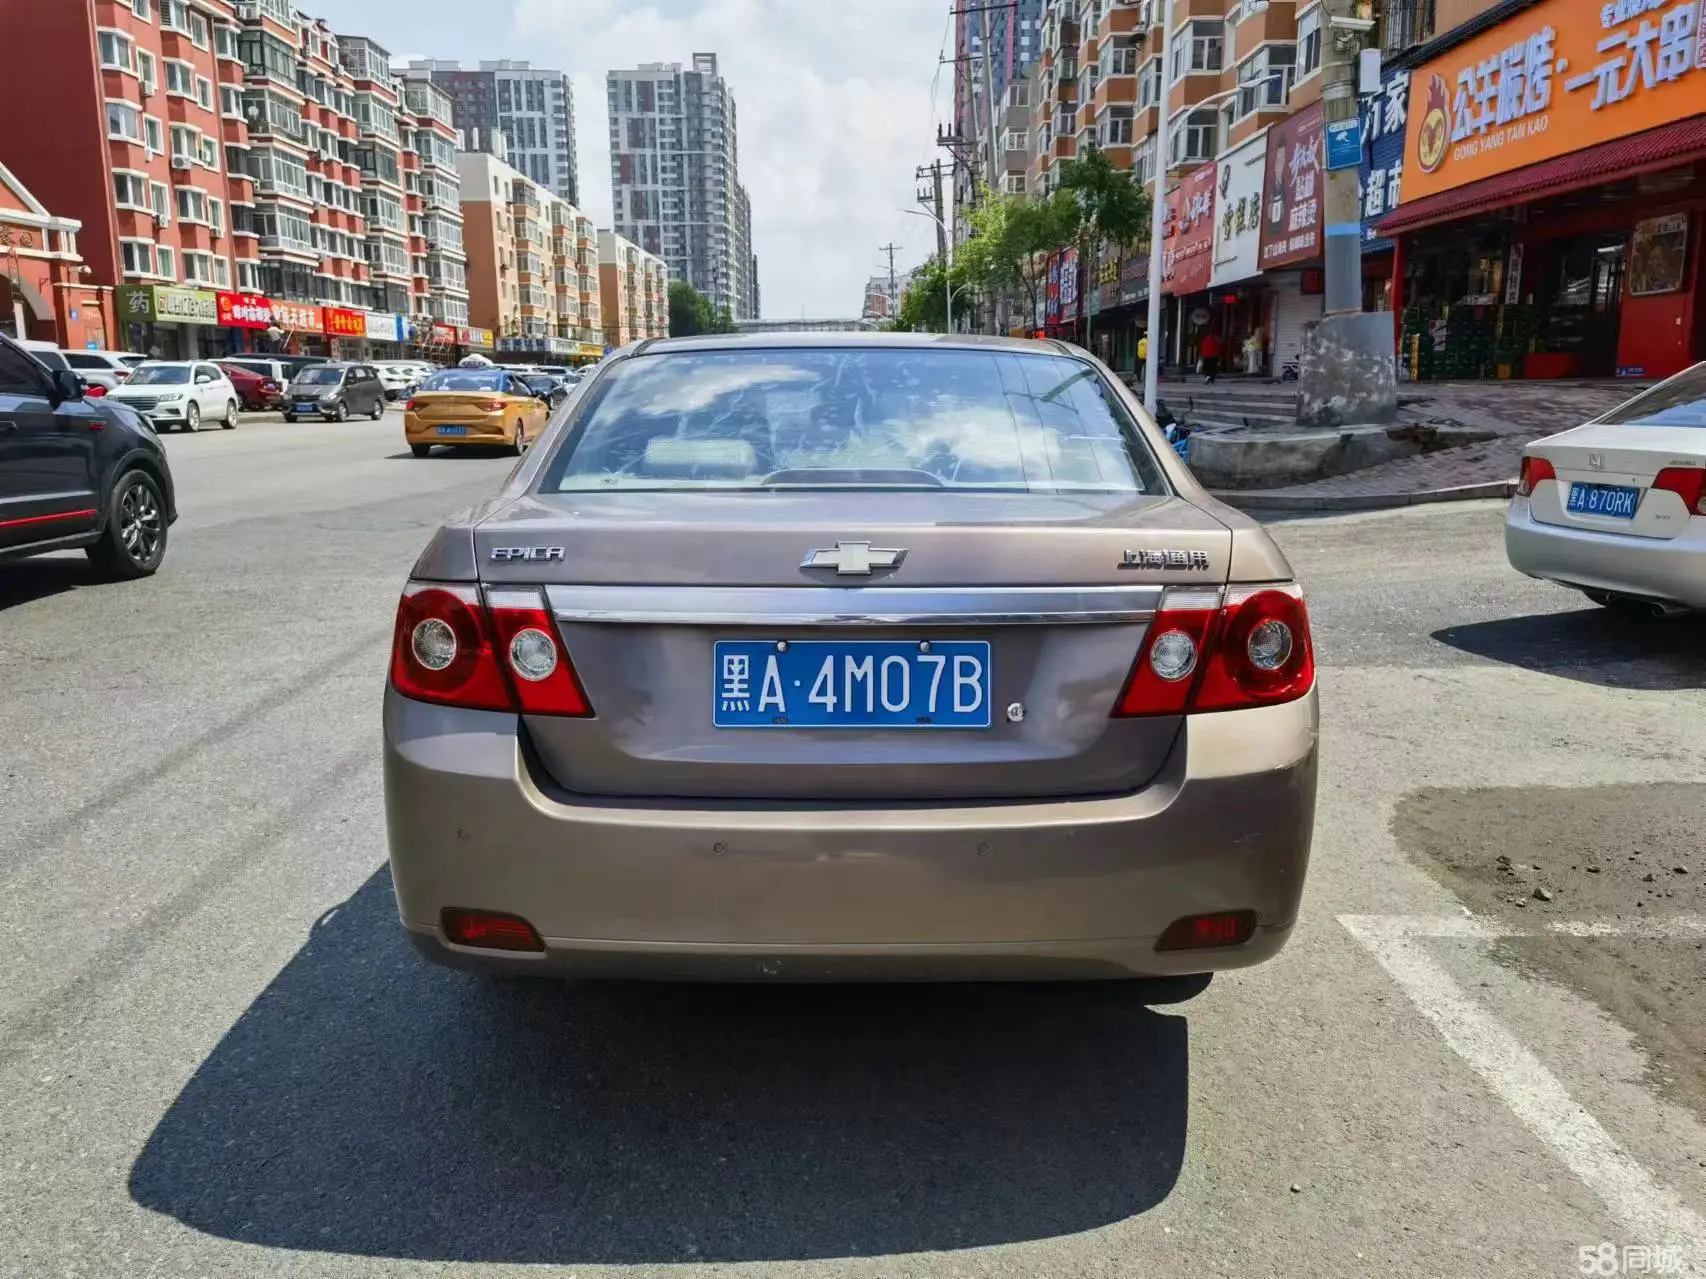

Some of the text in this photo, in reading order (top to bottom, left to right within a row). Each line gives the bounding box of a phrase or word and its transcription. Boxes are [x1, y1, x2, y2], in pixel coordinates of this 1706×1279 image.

[1454, 114, 1549, 161] GONG YANG TAN KAO
[1358, 159, 1401, 217] 超市
[126, 290, 150, 314] 药
[490, 546, 565, 560] EPICA
[1121, 547, 1208, 569] 上海通用
